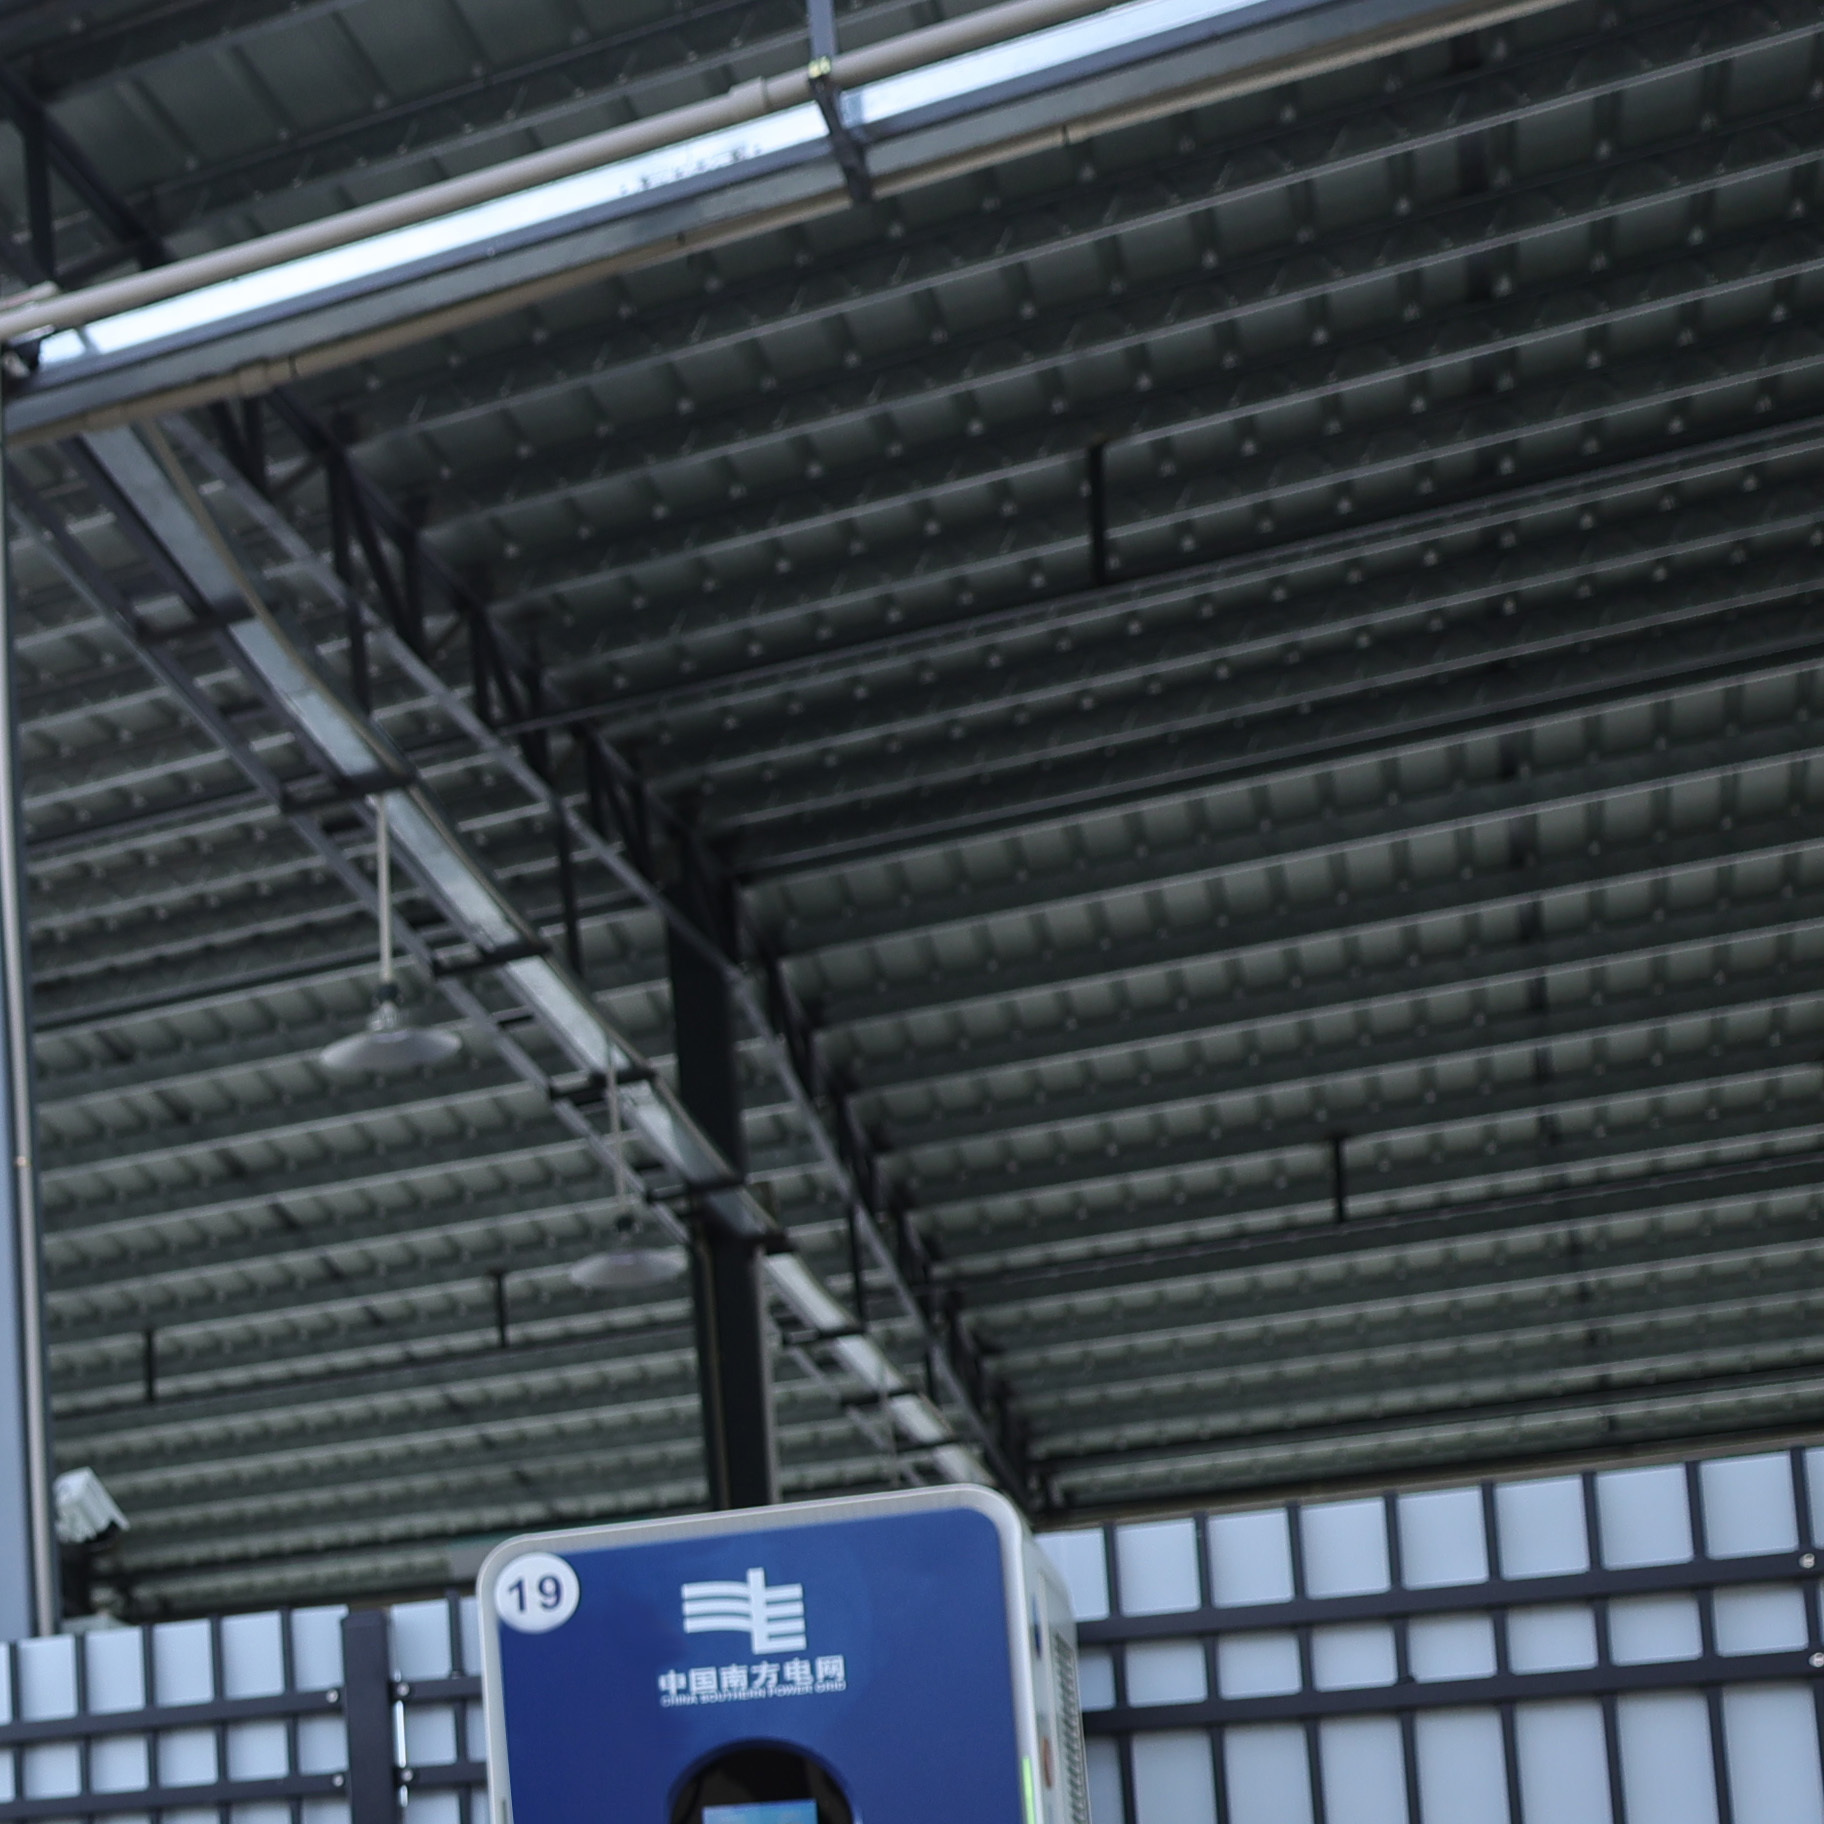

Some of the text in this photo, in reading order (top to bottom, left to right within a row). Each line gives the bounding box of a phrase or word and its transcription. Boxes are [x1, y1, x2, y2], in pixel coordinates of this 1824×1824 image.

[507, 1574, 564, 1613] 19
[659, 1654, 845, 1695] 中国南方电网
